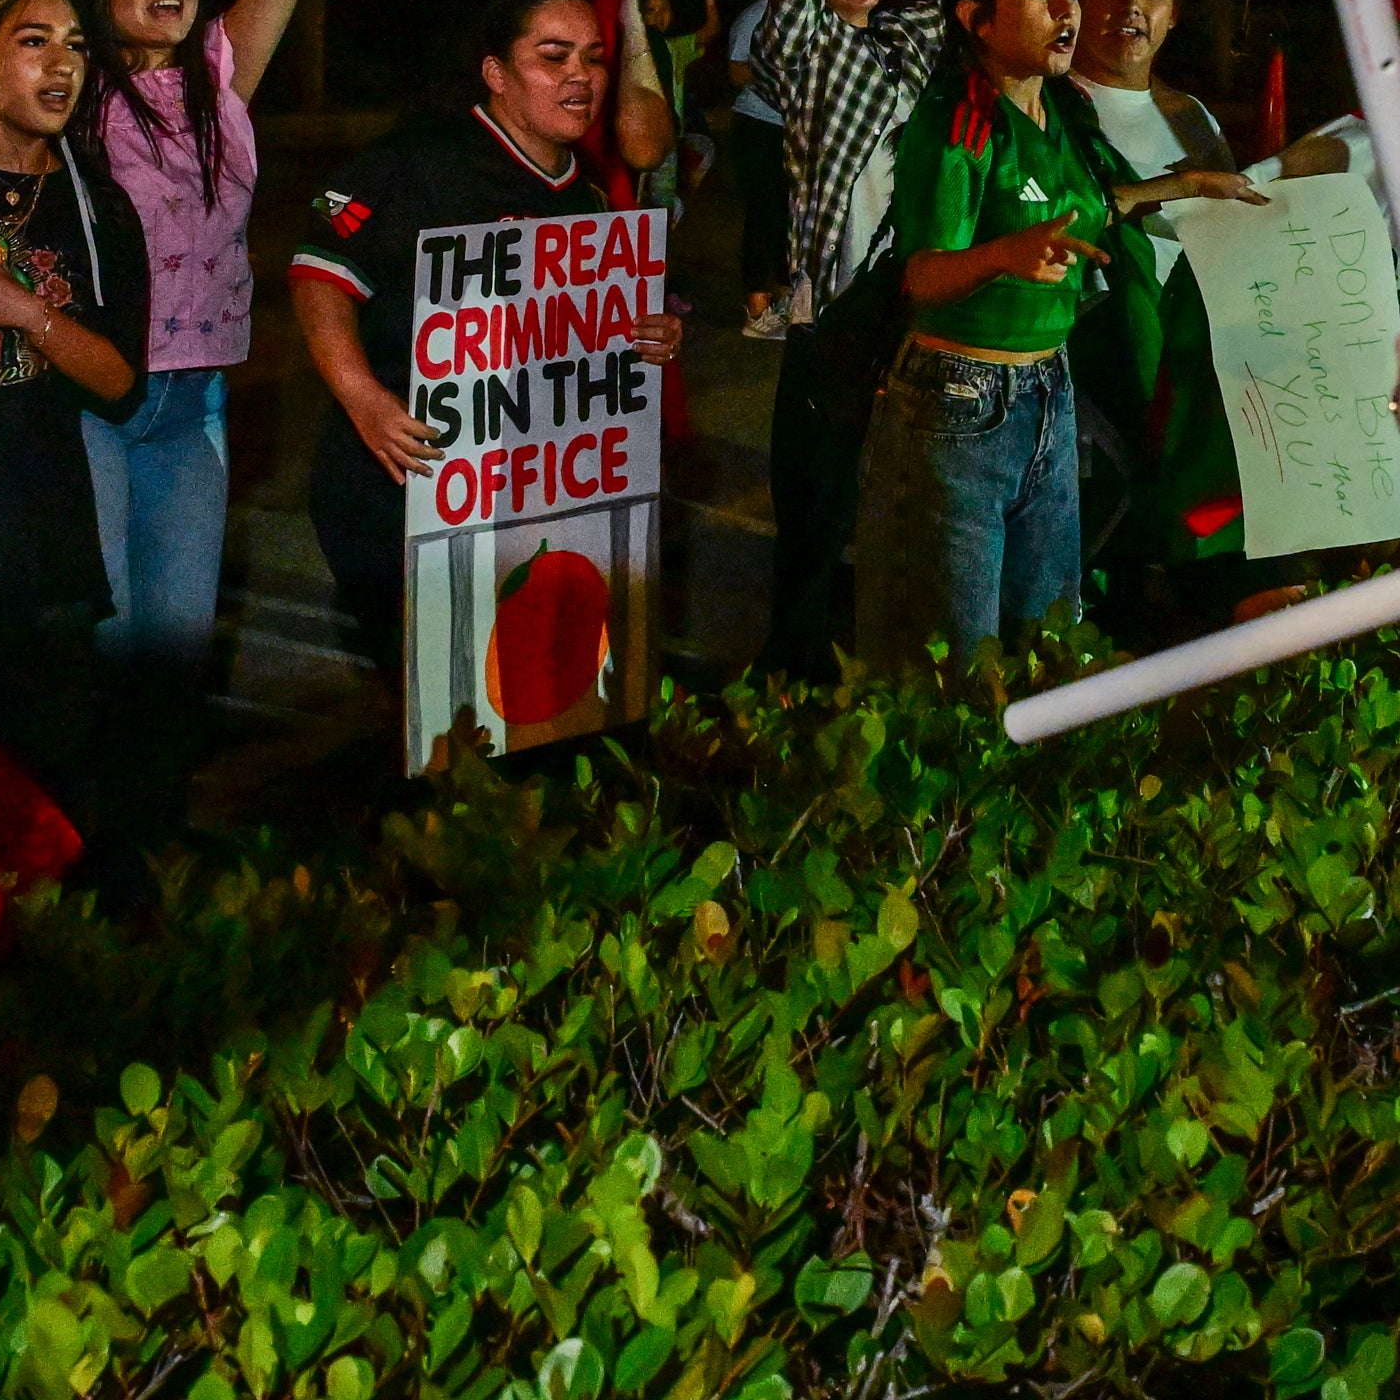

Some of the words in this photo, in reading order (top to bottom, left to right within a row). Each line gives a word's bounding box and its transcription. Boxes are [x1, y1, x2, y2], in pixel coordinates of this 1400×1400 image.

[421, 227, 522, 305] THE
[533, 213, 666, 291] REAL
[1247, 281, 1286, 340] feed
[1279, 220, 1317, 285] the
[1303, 320, 1343, 424] hands
[414, 381, 462, 449] IS
[472, 367, 531, 446] IN
[542, 350, 648, 428] THE
[435, 426, 629, 526] OFFICE
